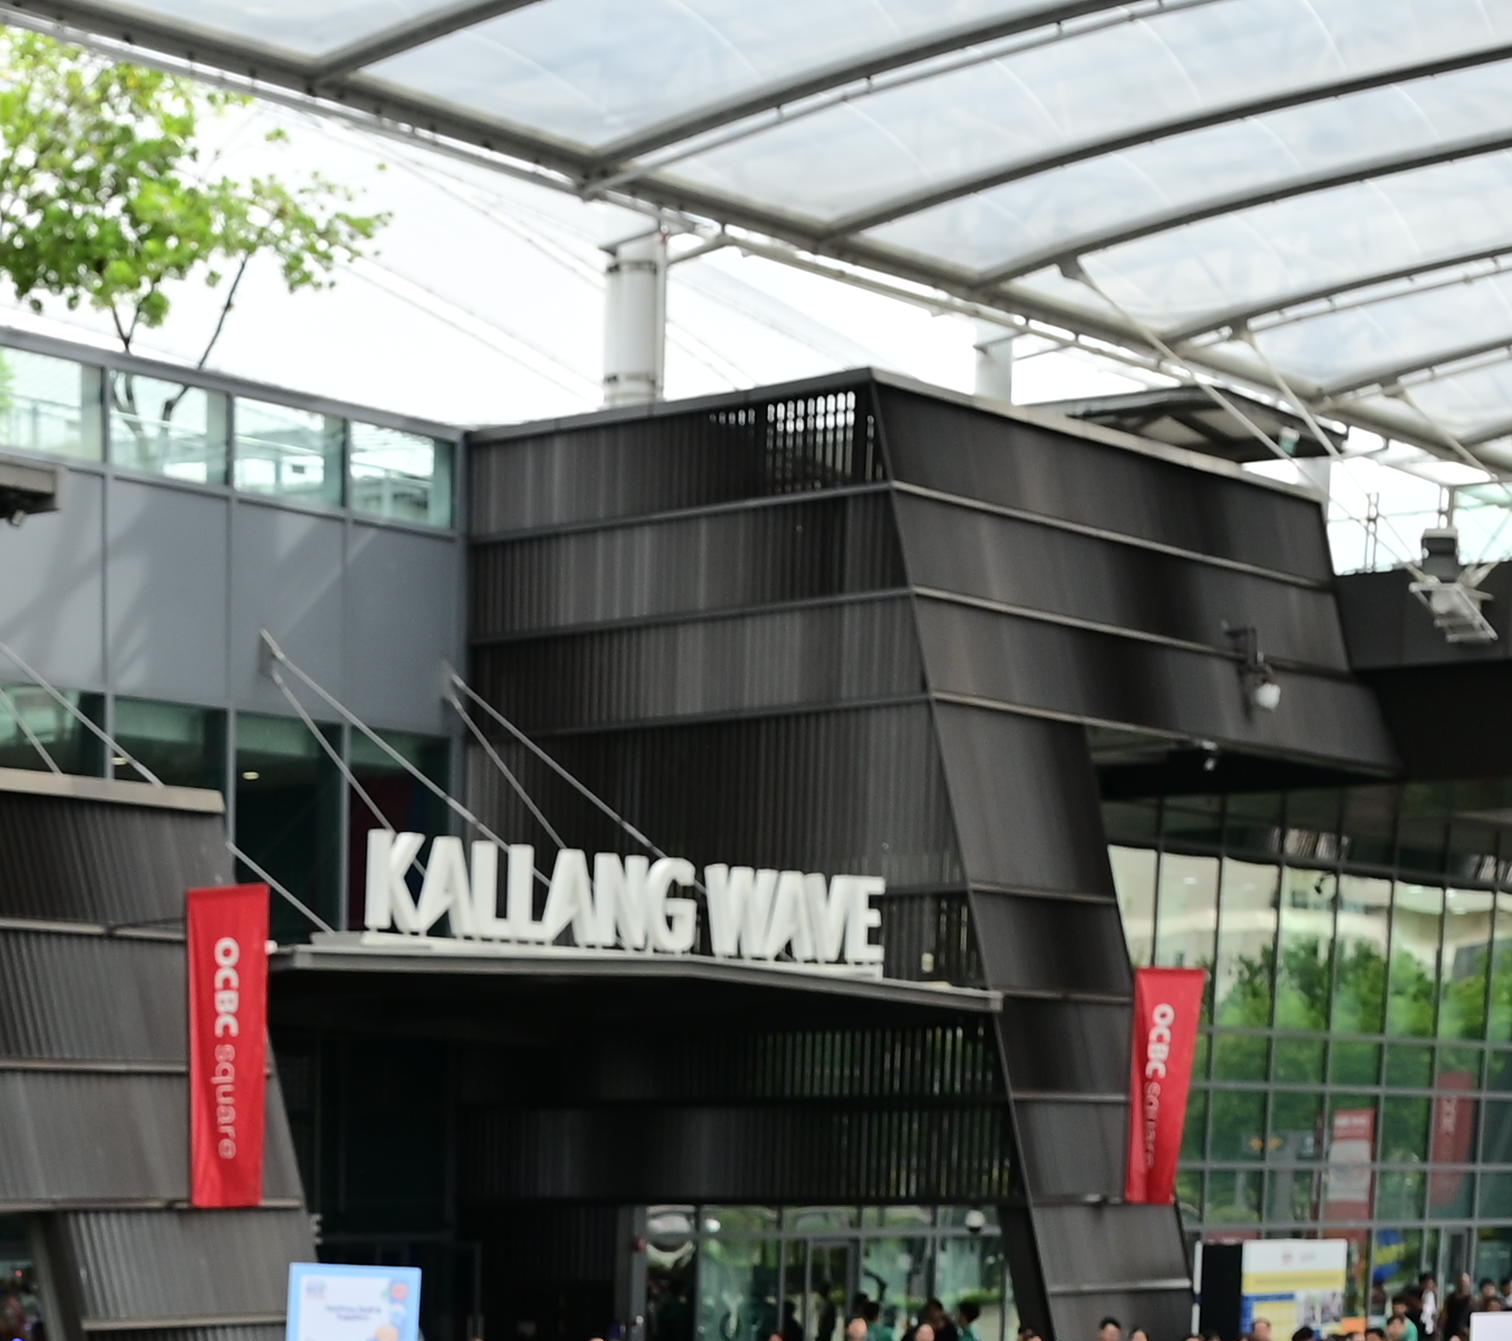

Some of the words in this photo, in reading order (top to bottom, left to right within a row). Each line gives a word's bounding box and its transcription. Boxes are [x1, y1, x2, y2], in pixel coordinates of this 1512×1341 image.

[364, 828, 698, 953] KALLANG
[704, 862, 885, 963] WAVE
[214, 936, 240, 1038] OCBC
[1145, 1003, 1175, 1079] OCBC
[210, 1043, 237, 1160] square
